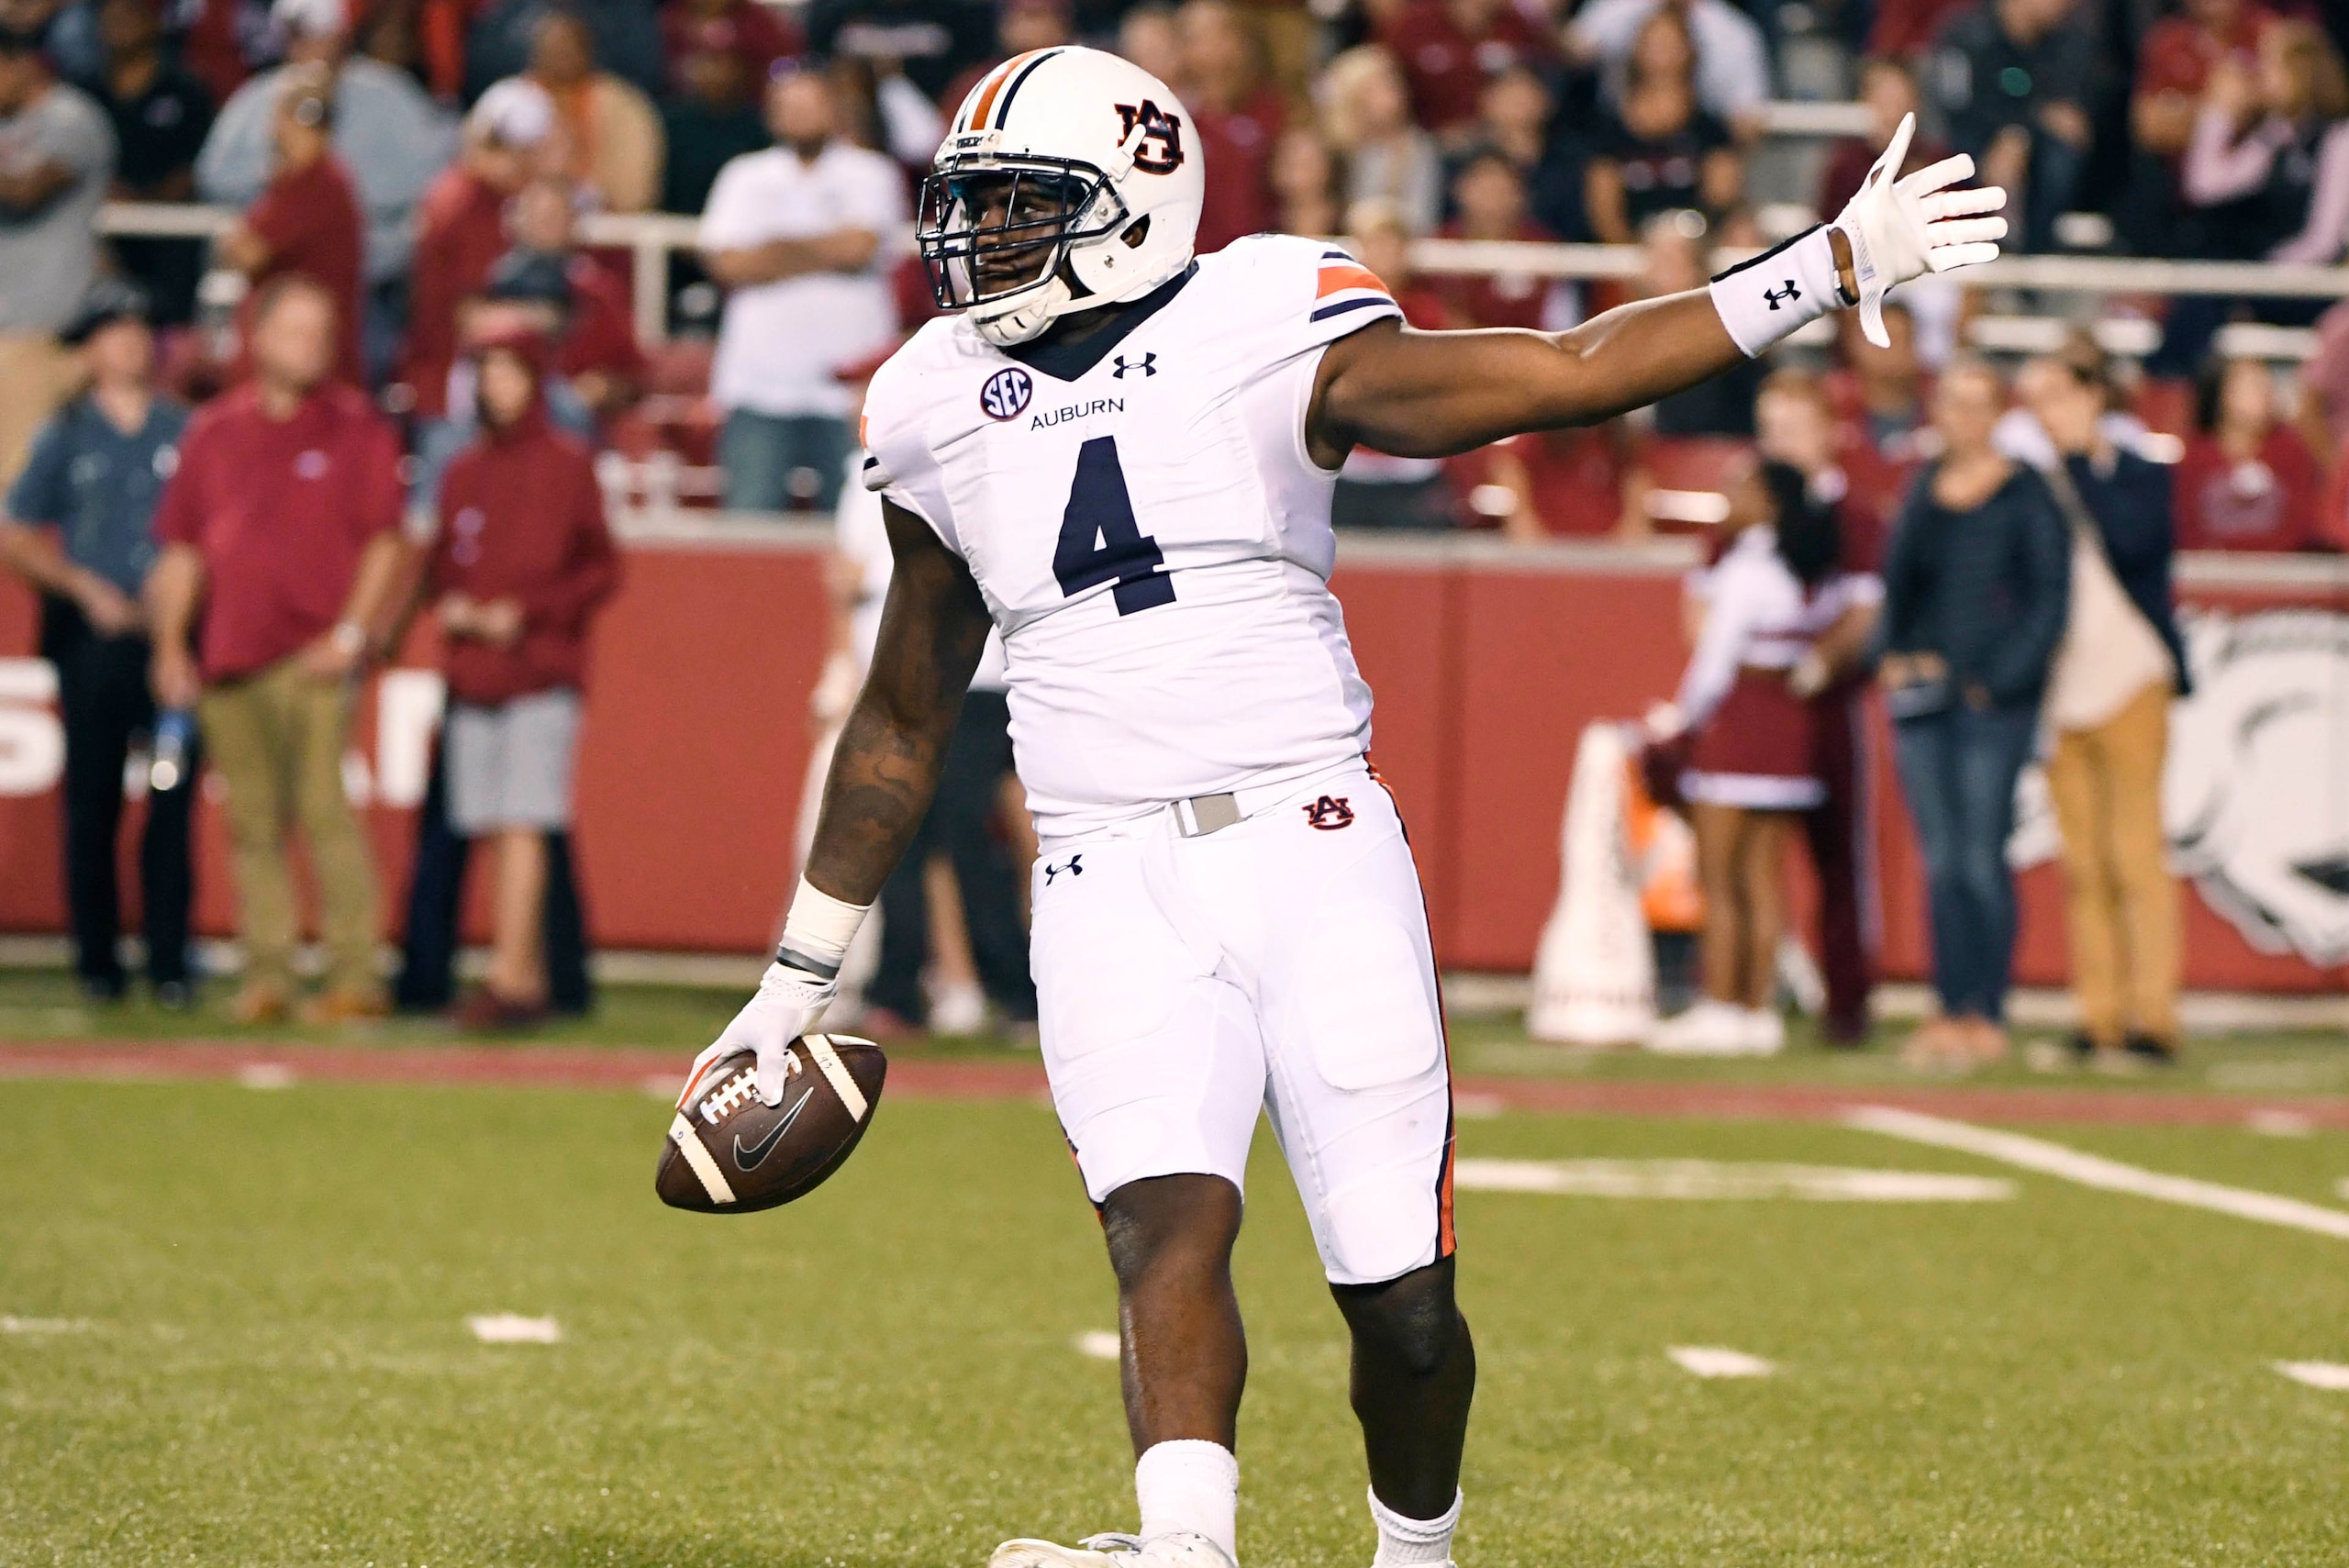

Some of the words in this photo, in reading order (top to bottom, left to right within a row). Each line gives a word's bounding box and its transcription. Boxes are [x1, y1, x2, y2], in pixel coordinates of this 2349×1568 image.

[983, 370, 1030, 417] SEC
[1030, 397, 1125, 431] AUBURN
[1052, 434, 1177, 617] 4
